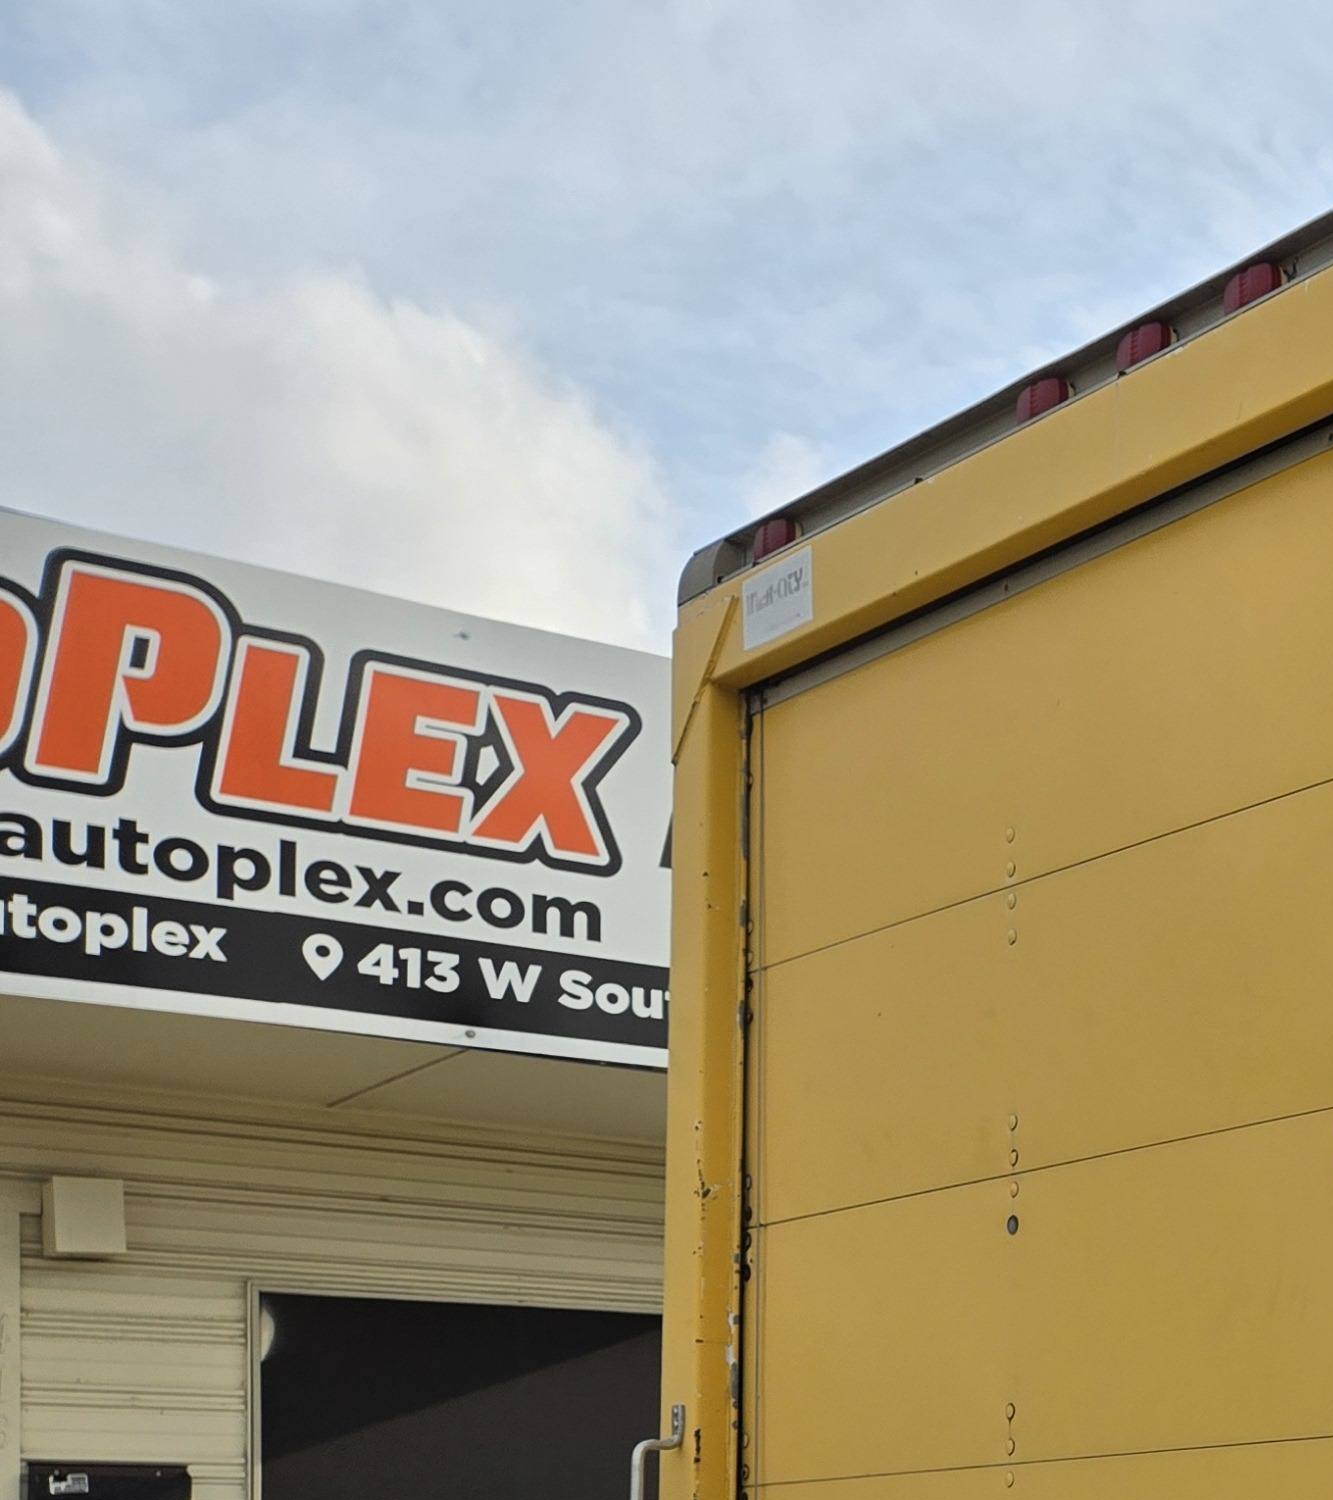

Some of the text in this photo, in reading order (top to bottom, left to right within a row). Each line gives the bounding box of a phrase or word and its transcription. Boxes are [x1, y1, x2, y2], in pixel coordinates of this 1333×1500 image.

[0, 893, 228, 964] toplex
[357, 944, 672, 1021] 413 W Sou
